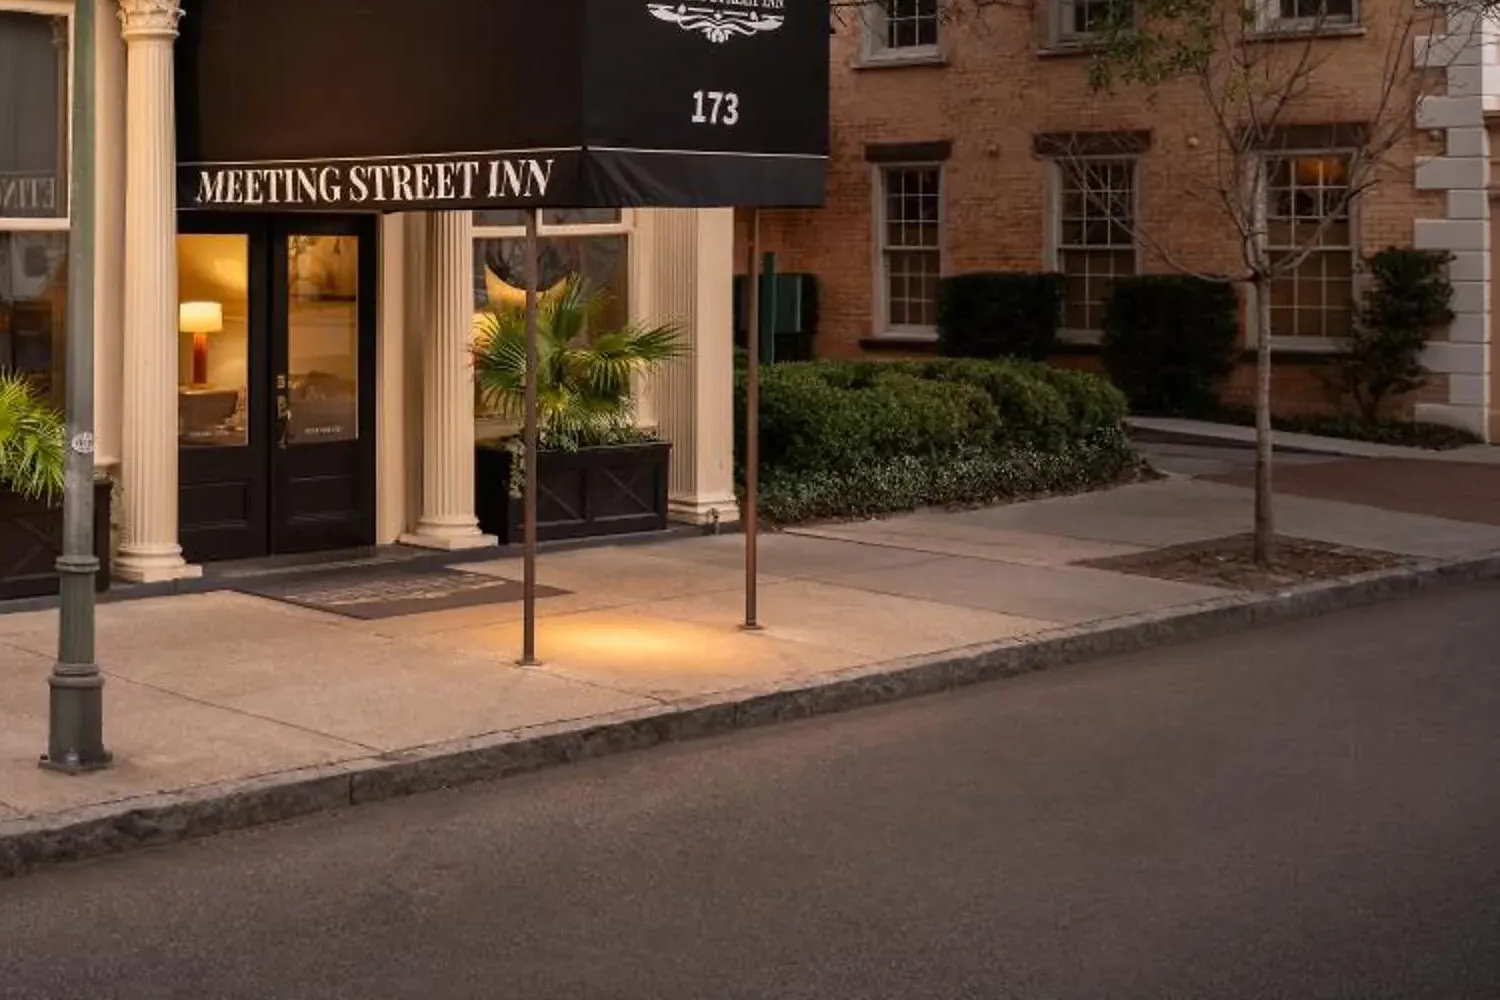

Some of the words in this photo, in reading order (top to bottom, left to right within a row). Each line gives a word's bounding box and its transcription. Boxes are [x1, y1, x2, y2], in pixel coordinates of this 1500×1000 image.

[691, 89, 740, 125] 173
[196, 165, 342, 204] MEETING
[349, 160, 480, 203] STREET
[487, 159, 555, 198] INN
